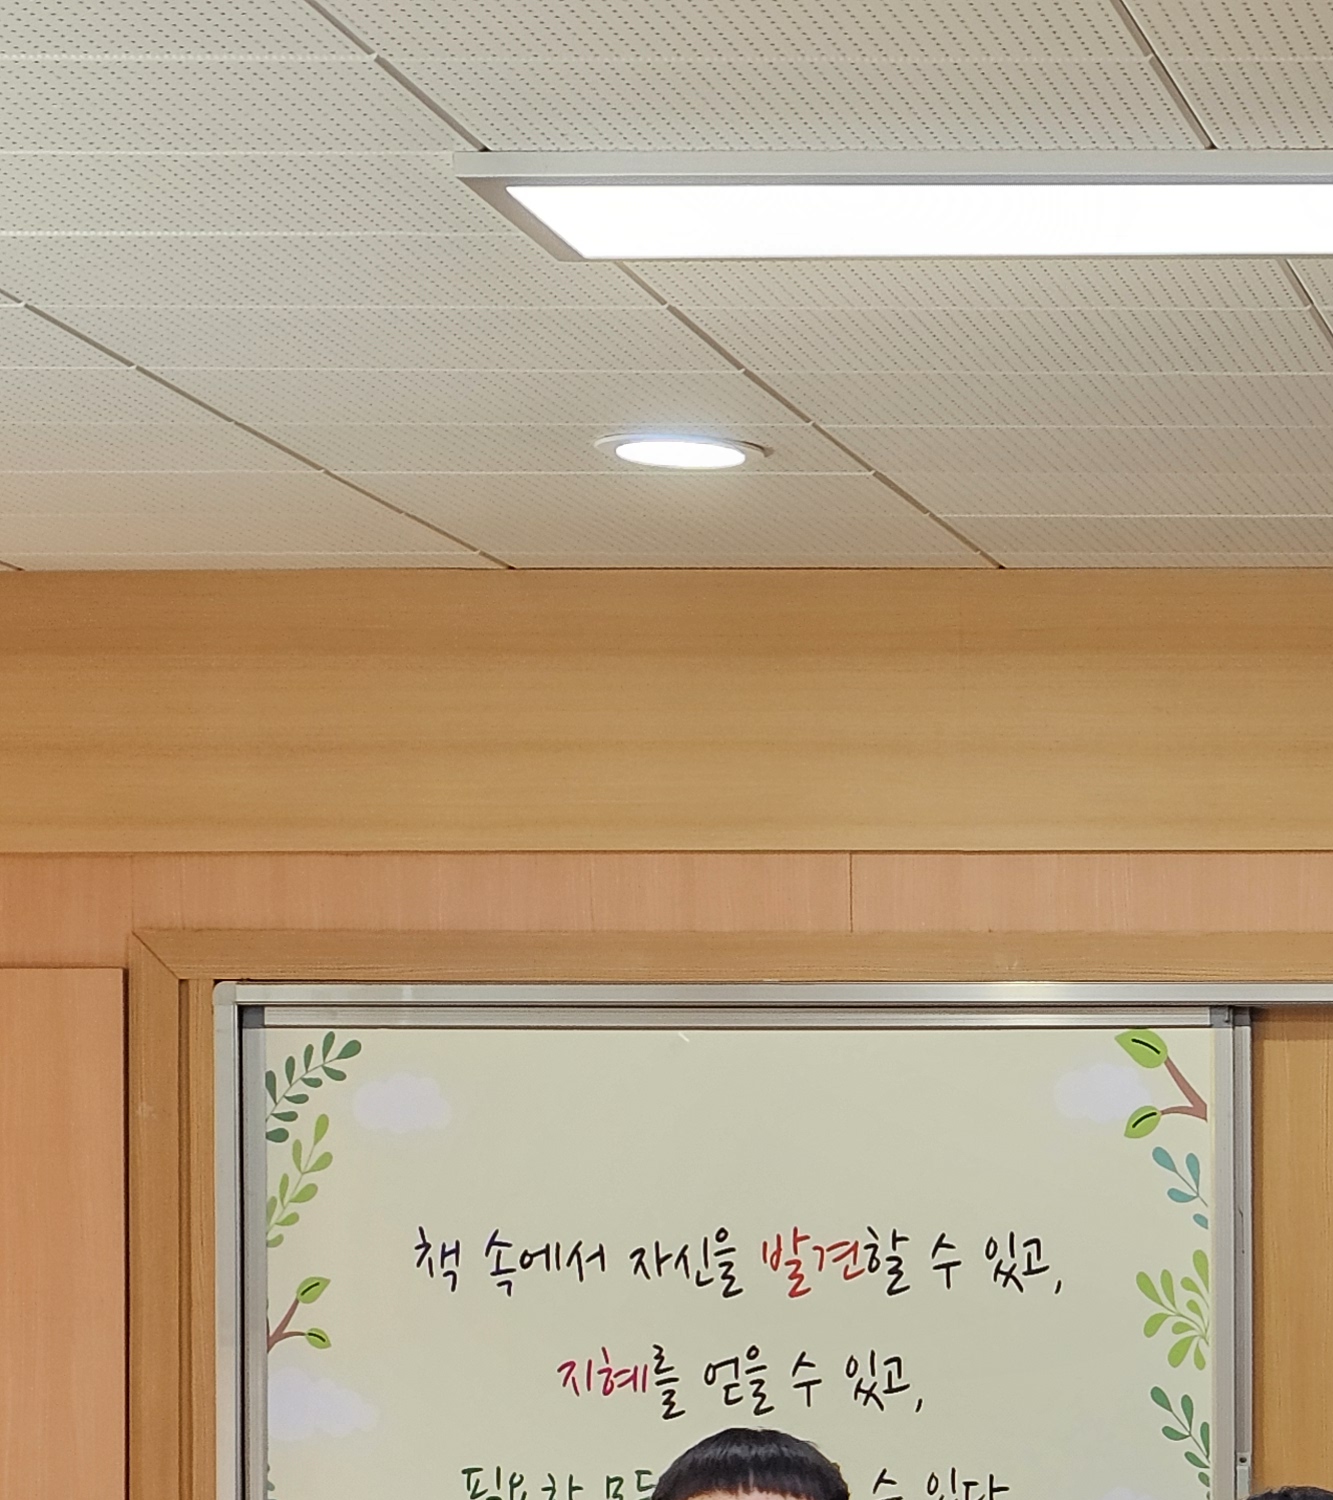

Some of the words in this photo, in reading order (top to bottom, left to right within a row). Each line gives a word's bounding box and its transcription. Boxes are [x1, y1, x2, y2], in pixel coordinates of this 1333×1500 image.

[415, 1226, 460, 1292] 책
[485, 1228, 606, 1297] 속에서
[628, 1226, 743, 1298] 자신을
[761, 1225, 911, 1298] 발견할
[931, 1232, 962, 1289] 수
[984, 1230, 1063, 1295] 있고,
[556, 1343, 686, 1421] 지혜를
[703, 1344, 774, 1416] 얻을
[791, 1350, 822, 1407] 수
[845, 1349, 923, 1413] 있고,
